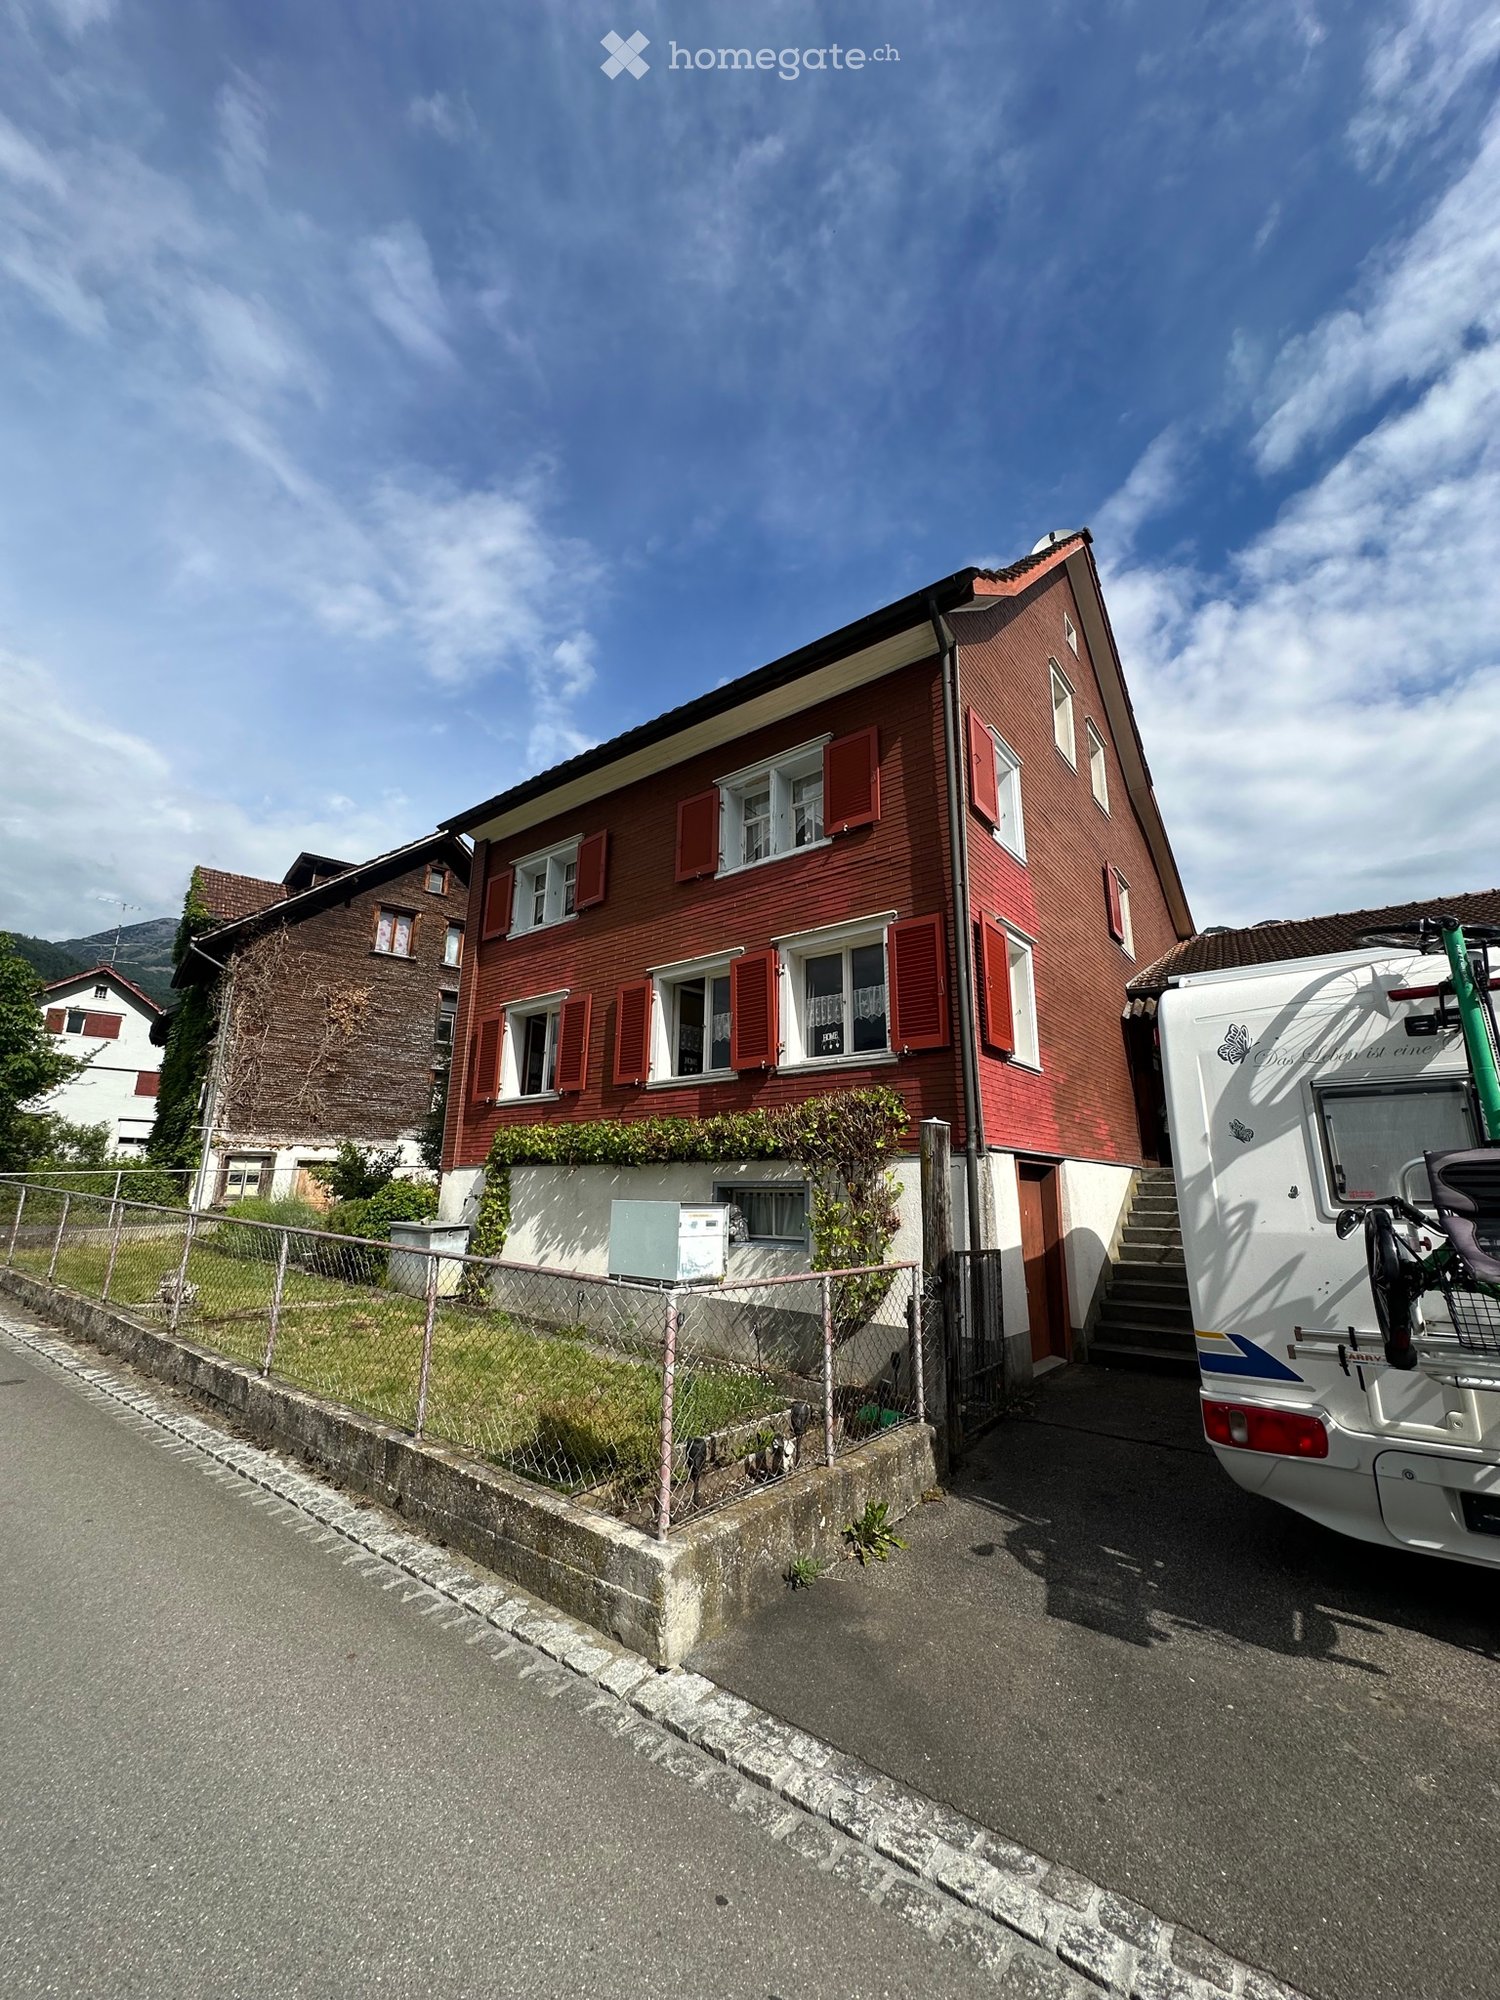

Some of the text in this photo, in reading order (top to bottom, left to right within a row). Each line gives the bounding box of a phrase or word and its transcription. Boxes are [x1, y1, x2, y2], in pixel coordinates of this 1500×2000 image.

[822, 1031, 839, 1042] HOME
[1253, 1047, 1294, 1068] Das
[1300, 1044, 1359, 1064] Leben
[1366, 1046, 1385, 1059] ist
[1393, 1044, 1432, 1057] eine
